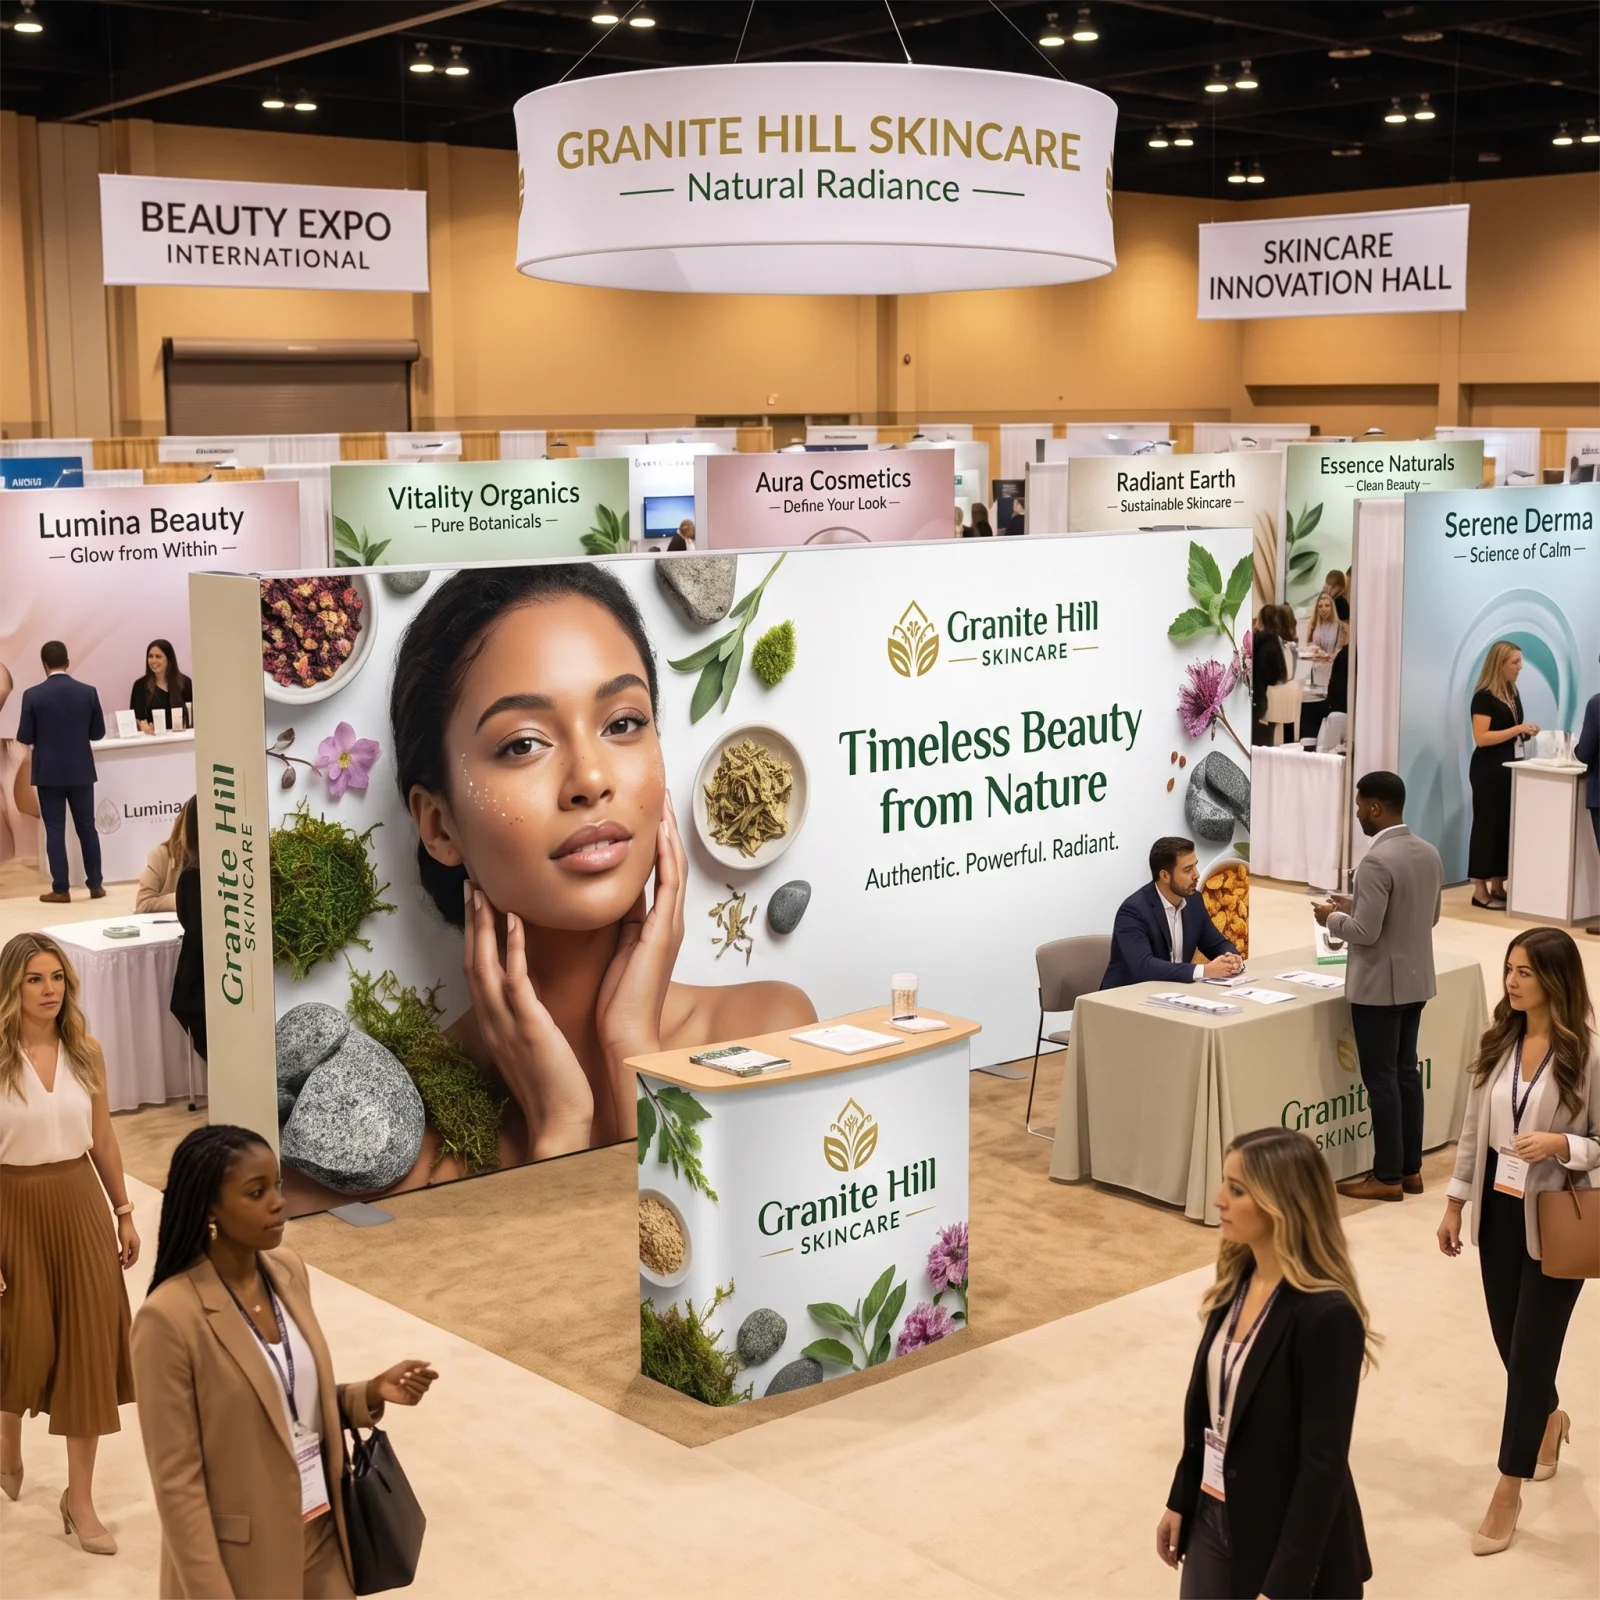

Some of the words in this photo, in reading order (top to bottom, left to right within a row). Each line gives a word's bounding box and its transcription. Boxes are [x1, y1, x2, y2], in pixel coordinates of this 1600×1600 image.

[557, 116, 742, 169] GRANITE
[759, 115, 856, 153] HILL
[869, 115, 1081, 172] SKINCARE
[689, 169, 803, 202] Natural
[818, 169, 959, 202] Radiance
[142, 201, 287, 237] BEAUTY
[300, 209, 391, 241] EXPO
[168, 244, 370, 269] INTERNATIONAL
[1264, 232, 1393, 264] SKINCARE
[1211, 269, 1372, 300] INNOVATION
[1383, 265, 1451, 292] HALL
[1321, 457, 1384, 474] Essence
[1390, 453, 1454, 472] Naturals
[756, 472, 803, 493] Aura
[811, 468, 911, 490] Cosmetics
[1118, 471, 1184, 492] Radiant
[1191, 469, 1235, 489] Earth
[1357, 480, 1383, 491] Clean
[1386, 479, 1420, 492] Beauty
[388, 485, 473, 512] Vitality
[481, 481, 579, 510] Organics
[784, 499, 823, 513] Define
[827, 498, 855, 511] Your
[859, 496, 887, 510] Look
[1121, 497, 1183, 512] Sustainable
[1187, 497, 1231, 509] Skincare
[40, 510, 140, 538] Lumina
[151, 507, 244, 535] Beauty
[432, 518, 464, 532] Pure
[470, 513, 541, 531] Botanicals
[1445, 512, 1518, 538] Serene
[1526, 508, 1592, 533] Derma
[71, 547, 114, 563] Glow
[119, 545, 157, 560] from
[163, 541, 217, 558] Within
[1470, 546, 1519, 563] Science
[1523, 543, 1536, 559] of
[1540, 542, 1570, 558] Calm
[948, 607, 1047, 642] Granite
[1056, 600, 1098, 633] Hill
[982, 643, 1067, 666] SKINCARE
[839, 720, 1010, 775] Timeless
[1021, 703, 1142, 753] Beauty
[124, 800, 181, 818] Lumina
[213, 764, 236, 834] Hill
[880, 788, 972, 833] from
[985, 771, 1107, 817] Nature
[865, 857, 959, 890] Authentic.
[967, 841, 1046, 874] Powerful.
[1053, 832, 1118, 859] Radiant.
[241, 823, 256, 951] SKINCARE
[218, 849, 244, 1005] Granite
[1315, 1121, 1375, 1151] SKINC
[758, 1182, 877, 1236] Granite
[887, 1158, 935, 1202] Hill
[801, 1210, 899, 1254] SKINCARE
